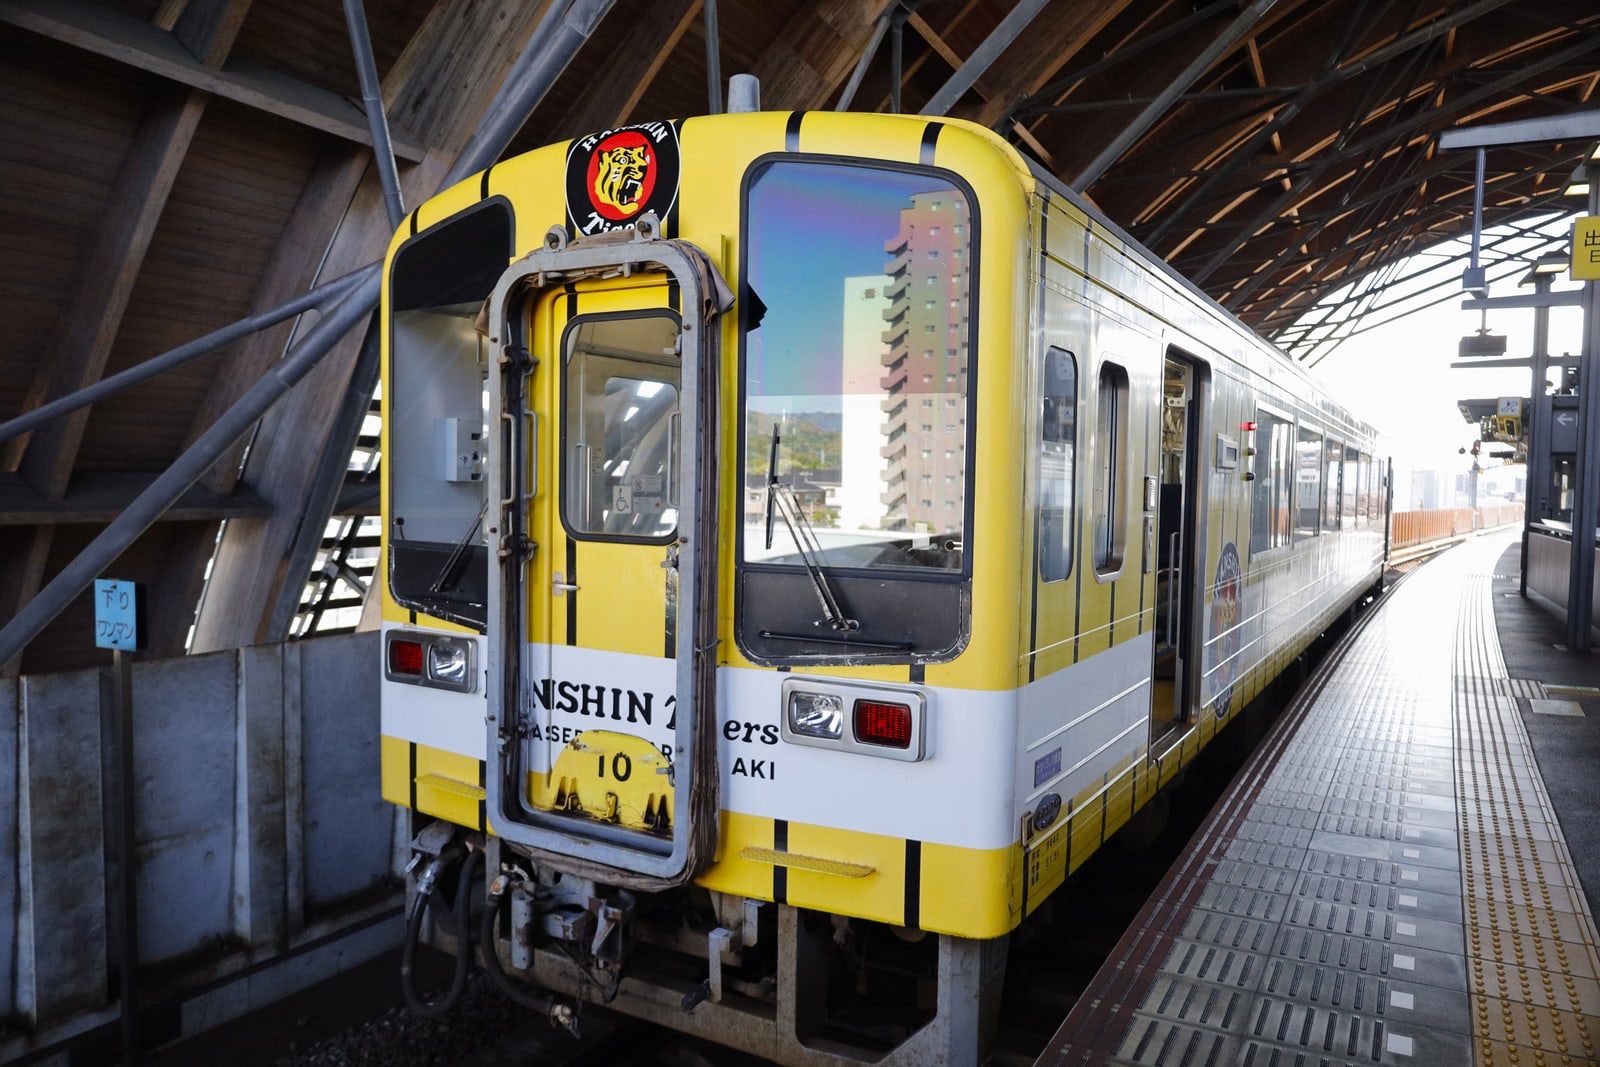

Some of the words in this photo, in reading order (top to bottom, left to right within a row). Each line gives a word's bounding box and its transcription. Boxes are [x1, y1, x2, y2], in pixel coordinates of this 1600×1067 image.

[1585, 229, 1600, 246] 出
[101, 589, 129, 610] 下り
[98, 620, 134, 640] ワンマン
[598, 751, 632, 782] 10
[731, 757, 775, 780] AKI
